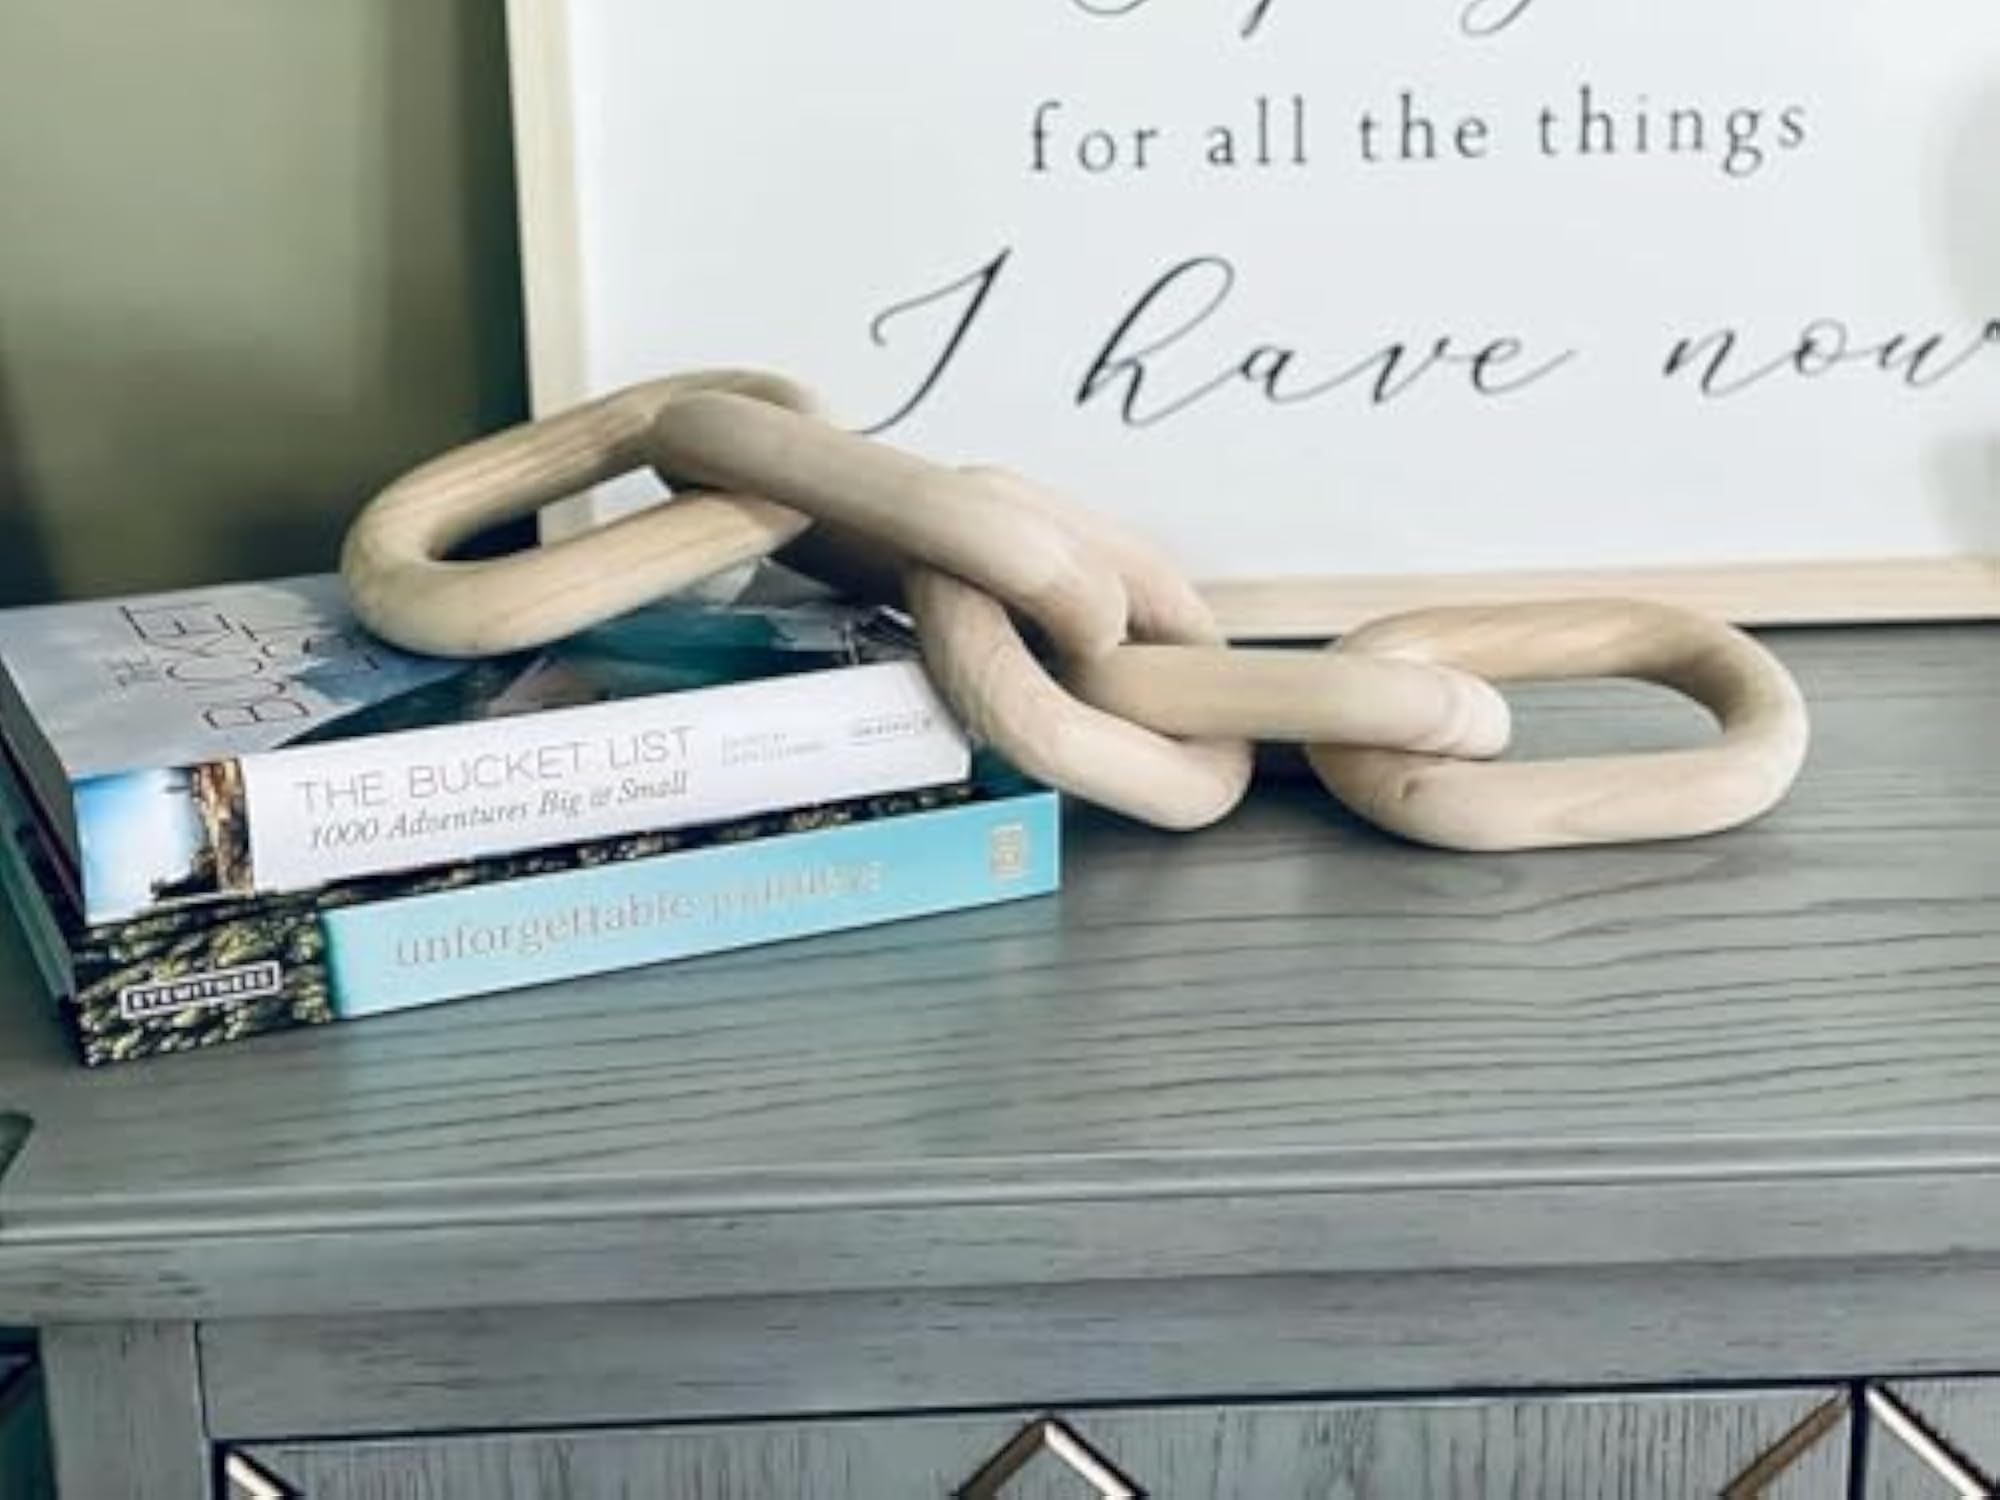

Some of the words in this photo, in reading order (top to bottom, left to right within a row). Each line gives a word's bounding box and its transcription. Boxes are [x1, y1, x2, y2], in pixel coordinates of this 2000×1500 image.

[1029, 100, 1159, 173] for
[1206, 96, 1308, 167] all
[1358, 91, 1490, 163] the
[1537, 84, 1807, 178] things
[858, 246, 1011, 435] I
[1075, 255, 1577, 427] have
[1662, 316, 2000, 398] now
[295, 770, 388, 813] THE
[408, 741, 591, 798] BUCKET
[606, 725, 694, 770] LIST
[309, 817, 380, 850] 1000
[386, 797, 528, 839] Adventures
[538, 787, 582, 819] Big
[617, 770, 689, 803] Small
[395, 888, 693, 968] unforgettable
[131, 970, 270, 1009] EYEWITNESS
